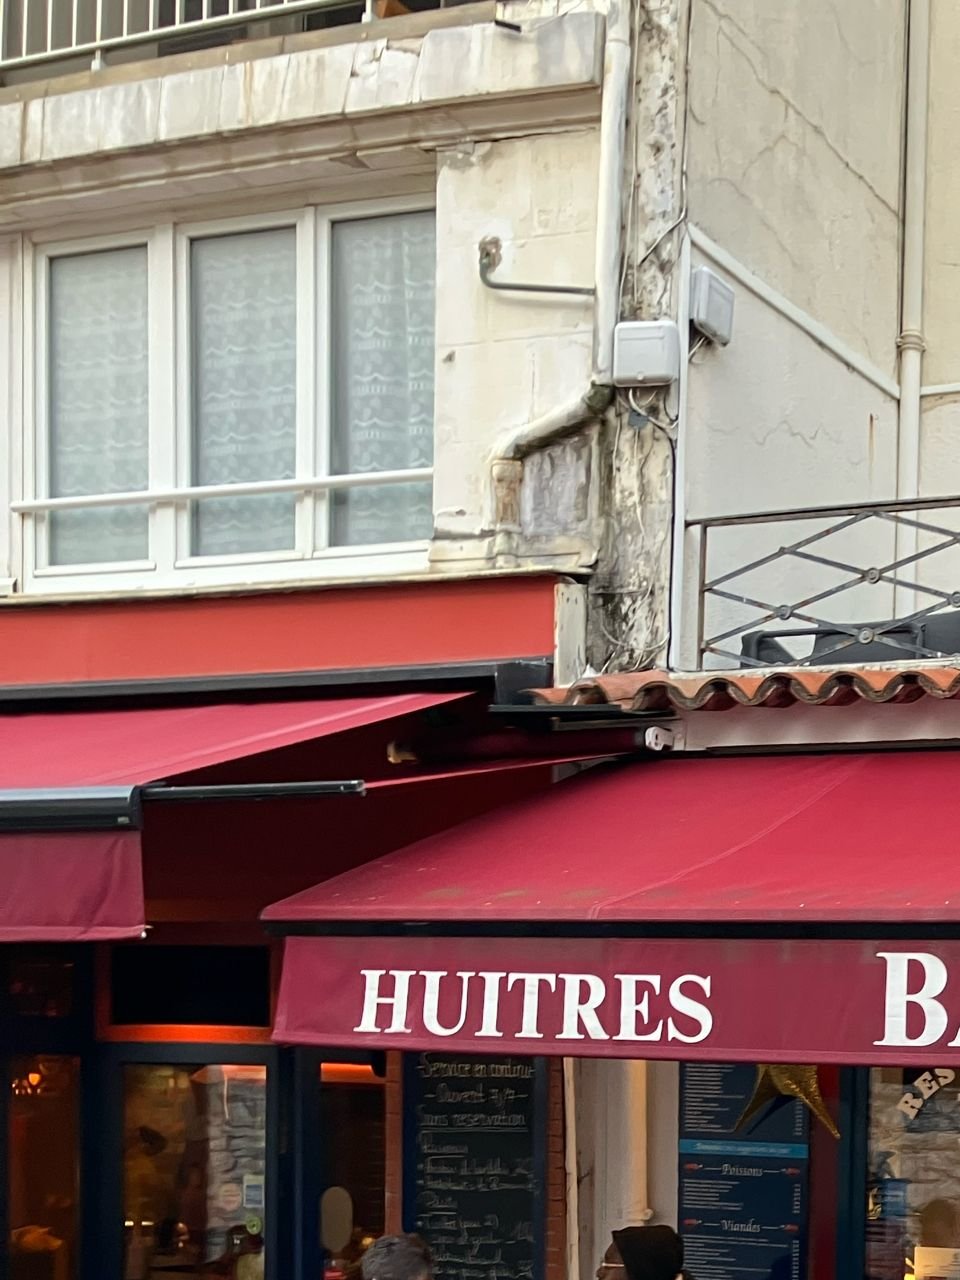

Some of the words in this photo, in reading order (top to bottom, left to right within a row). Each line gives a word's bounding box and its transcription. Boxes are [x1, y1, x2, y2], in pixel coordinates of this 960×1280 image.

[354, 970, 714, 1044] HUITRES
[721, 1163, 764, 1177] Poissons
[720, 1218, 761, 1233] Viandes
